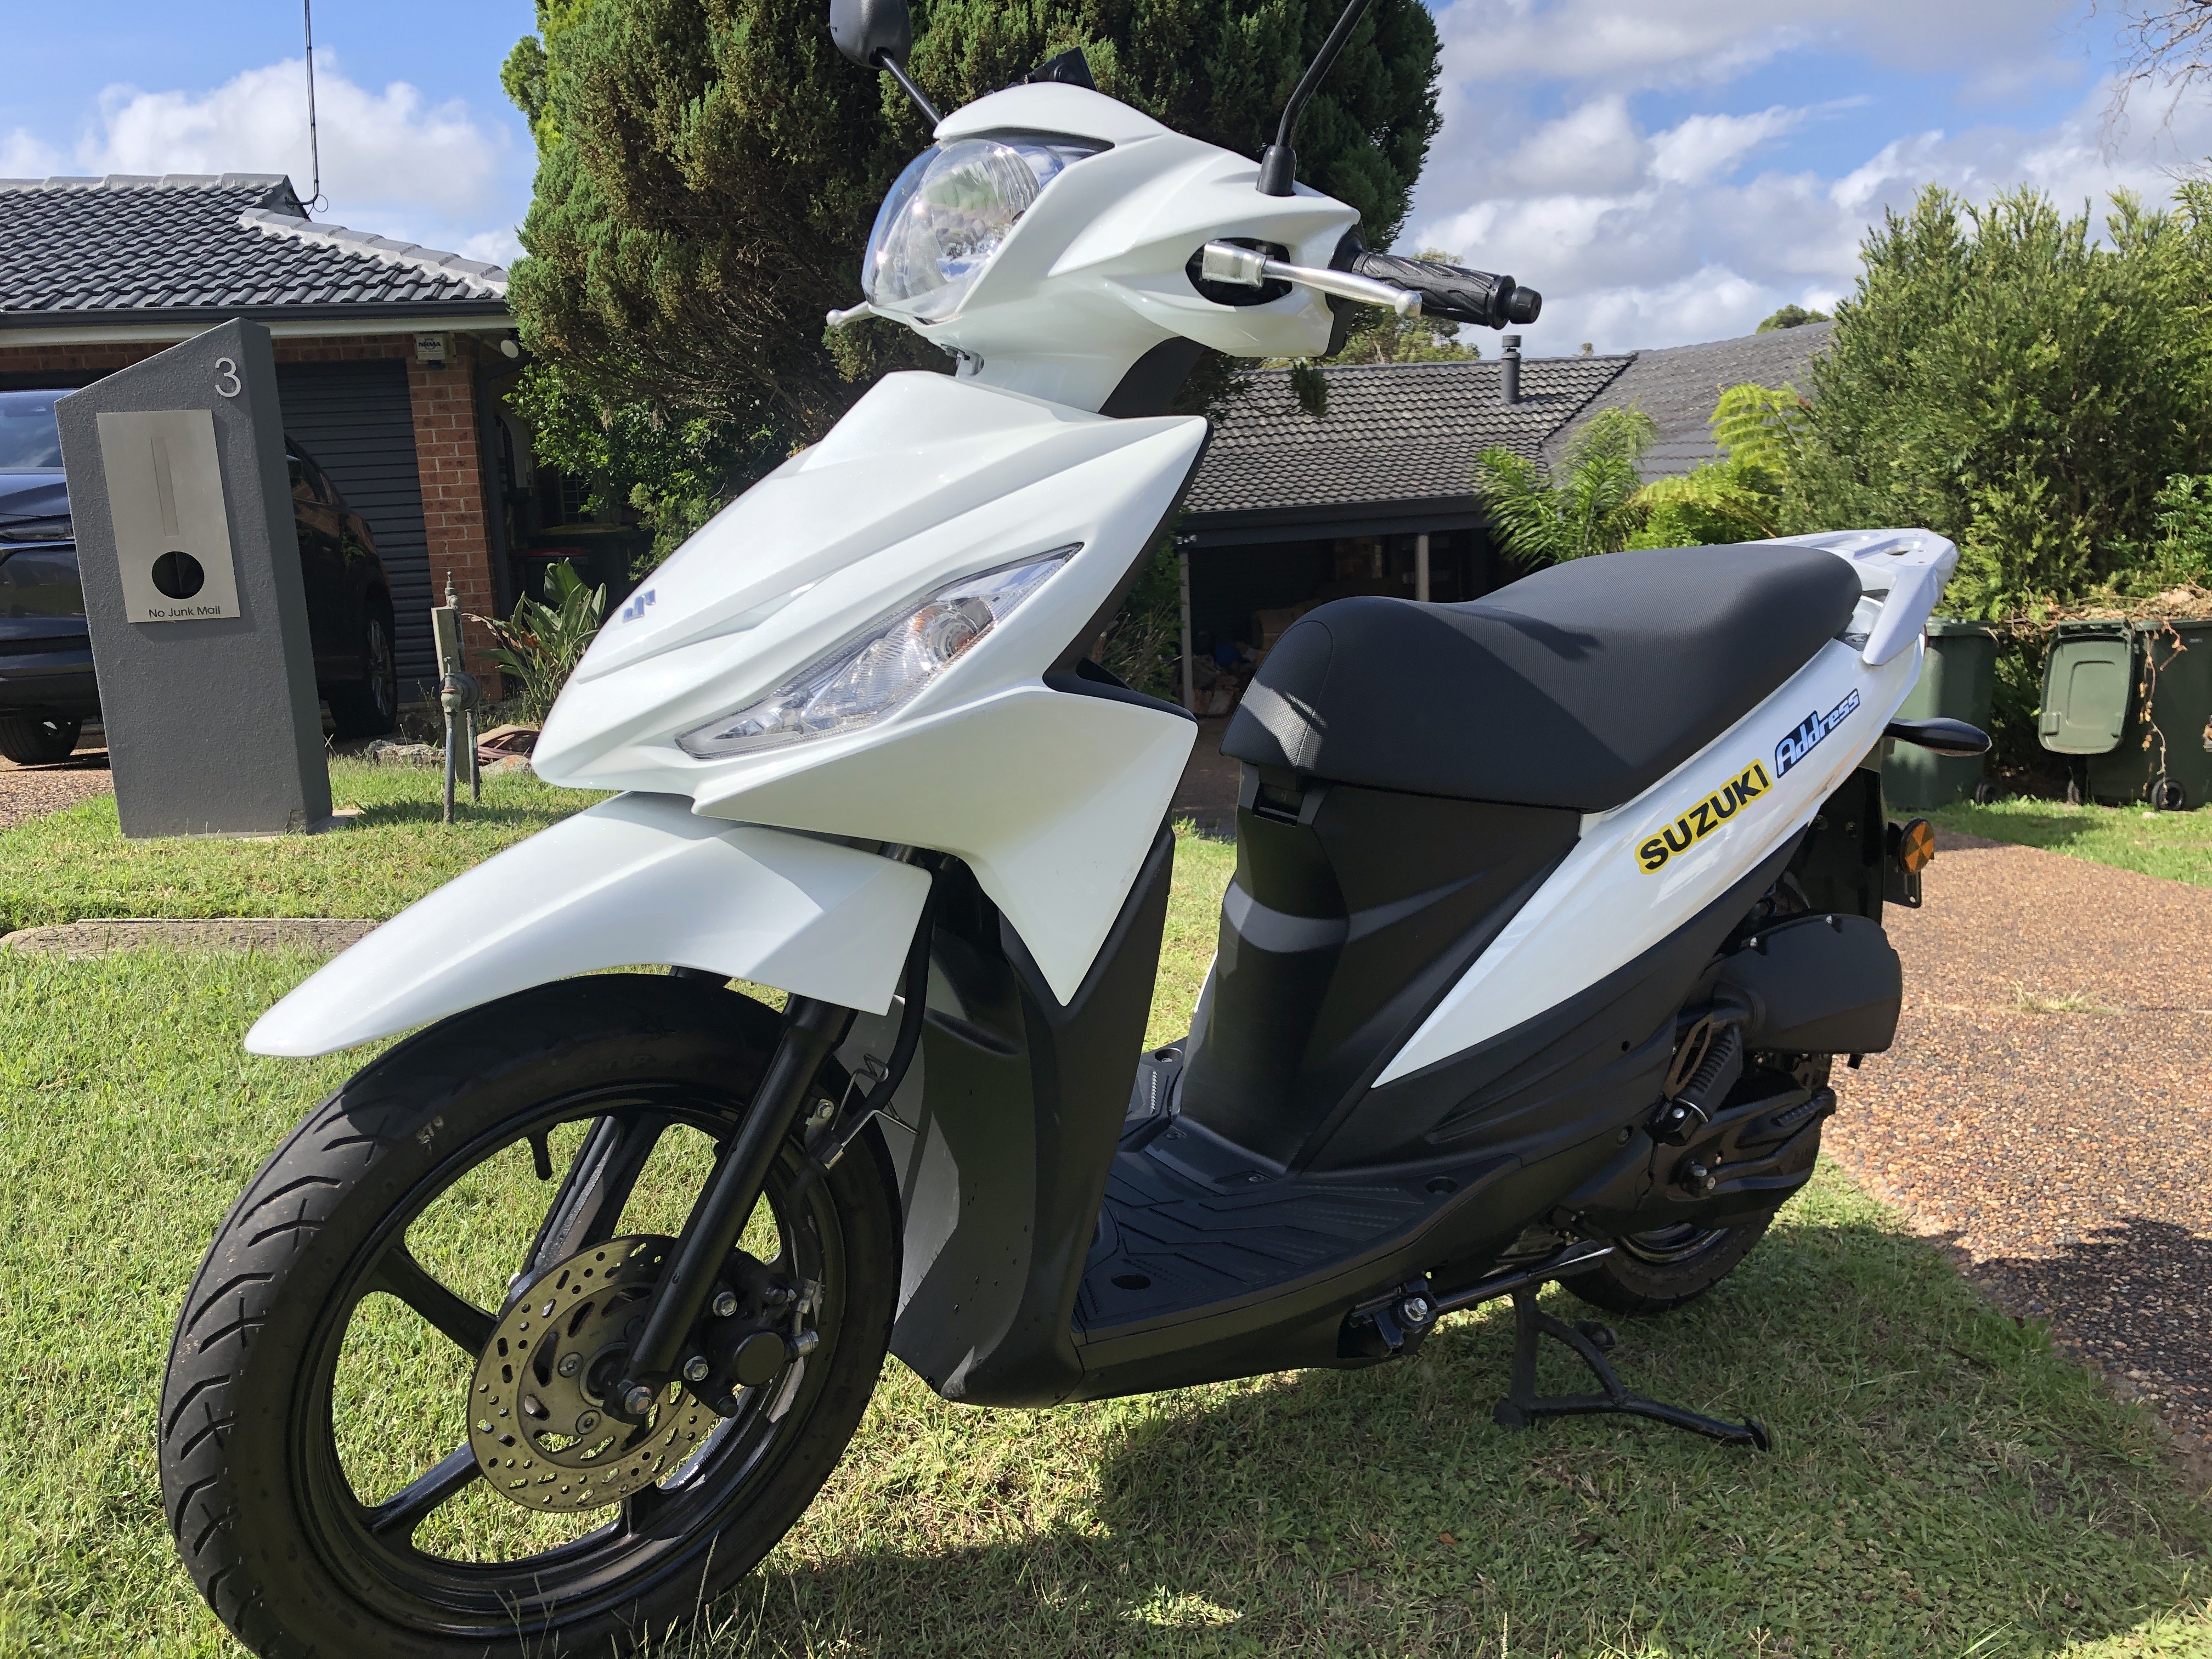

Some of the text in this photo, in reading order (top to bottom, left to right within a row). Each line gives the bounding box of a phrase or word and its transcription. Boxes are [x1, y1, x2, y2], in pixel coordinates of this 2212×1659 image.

[215, 357, 241, 397] 3
[148, 606, 221, 618] No Junk Mail
[1776, 689, 1860, 776] Address
[1640, 764, 1769, 870] SUZUKI
